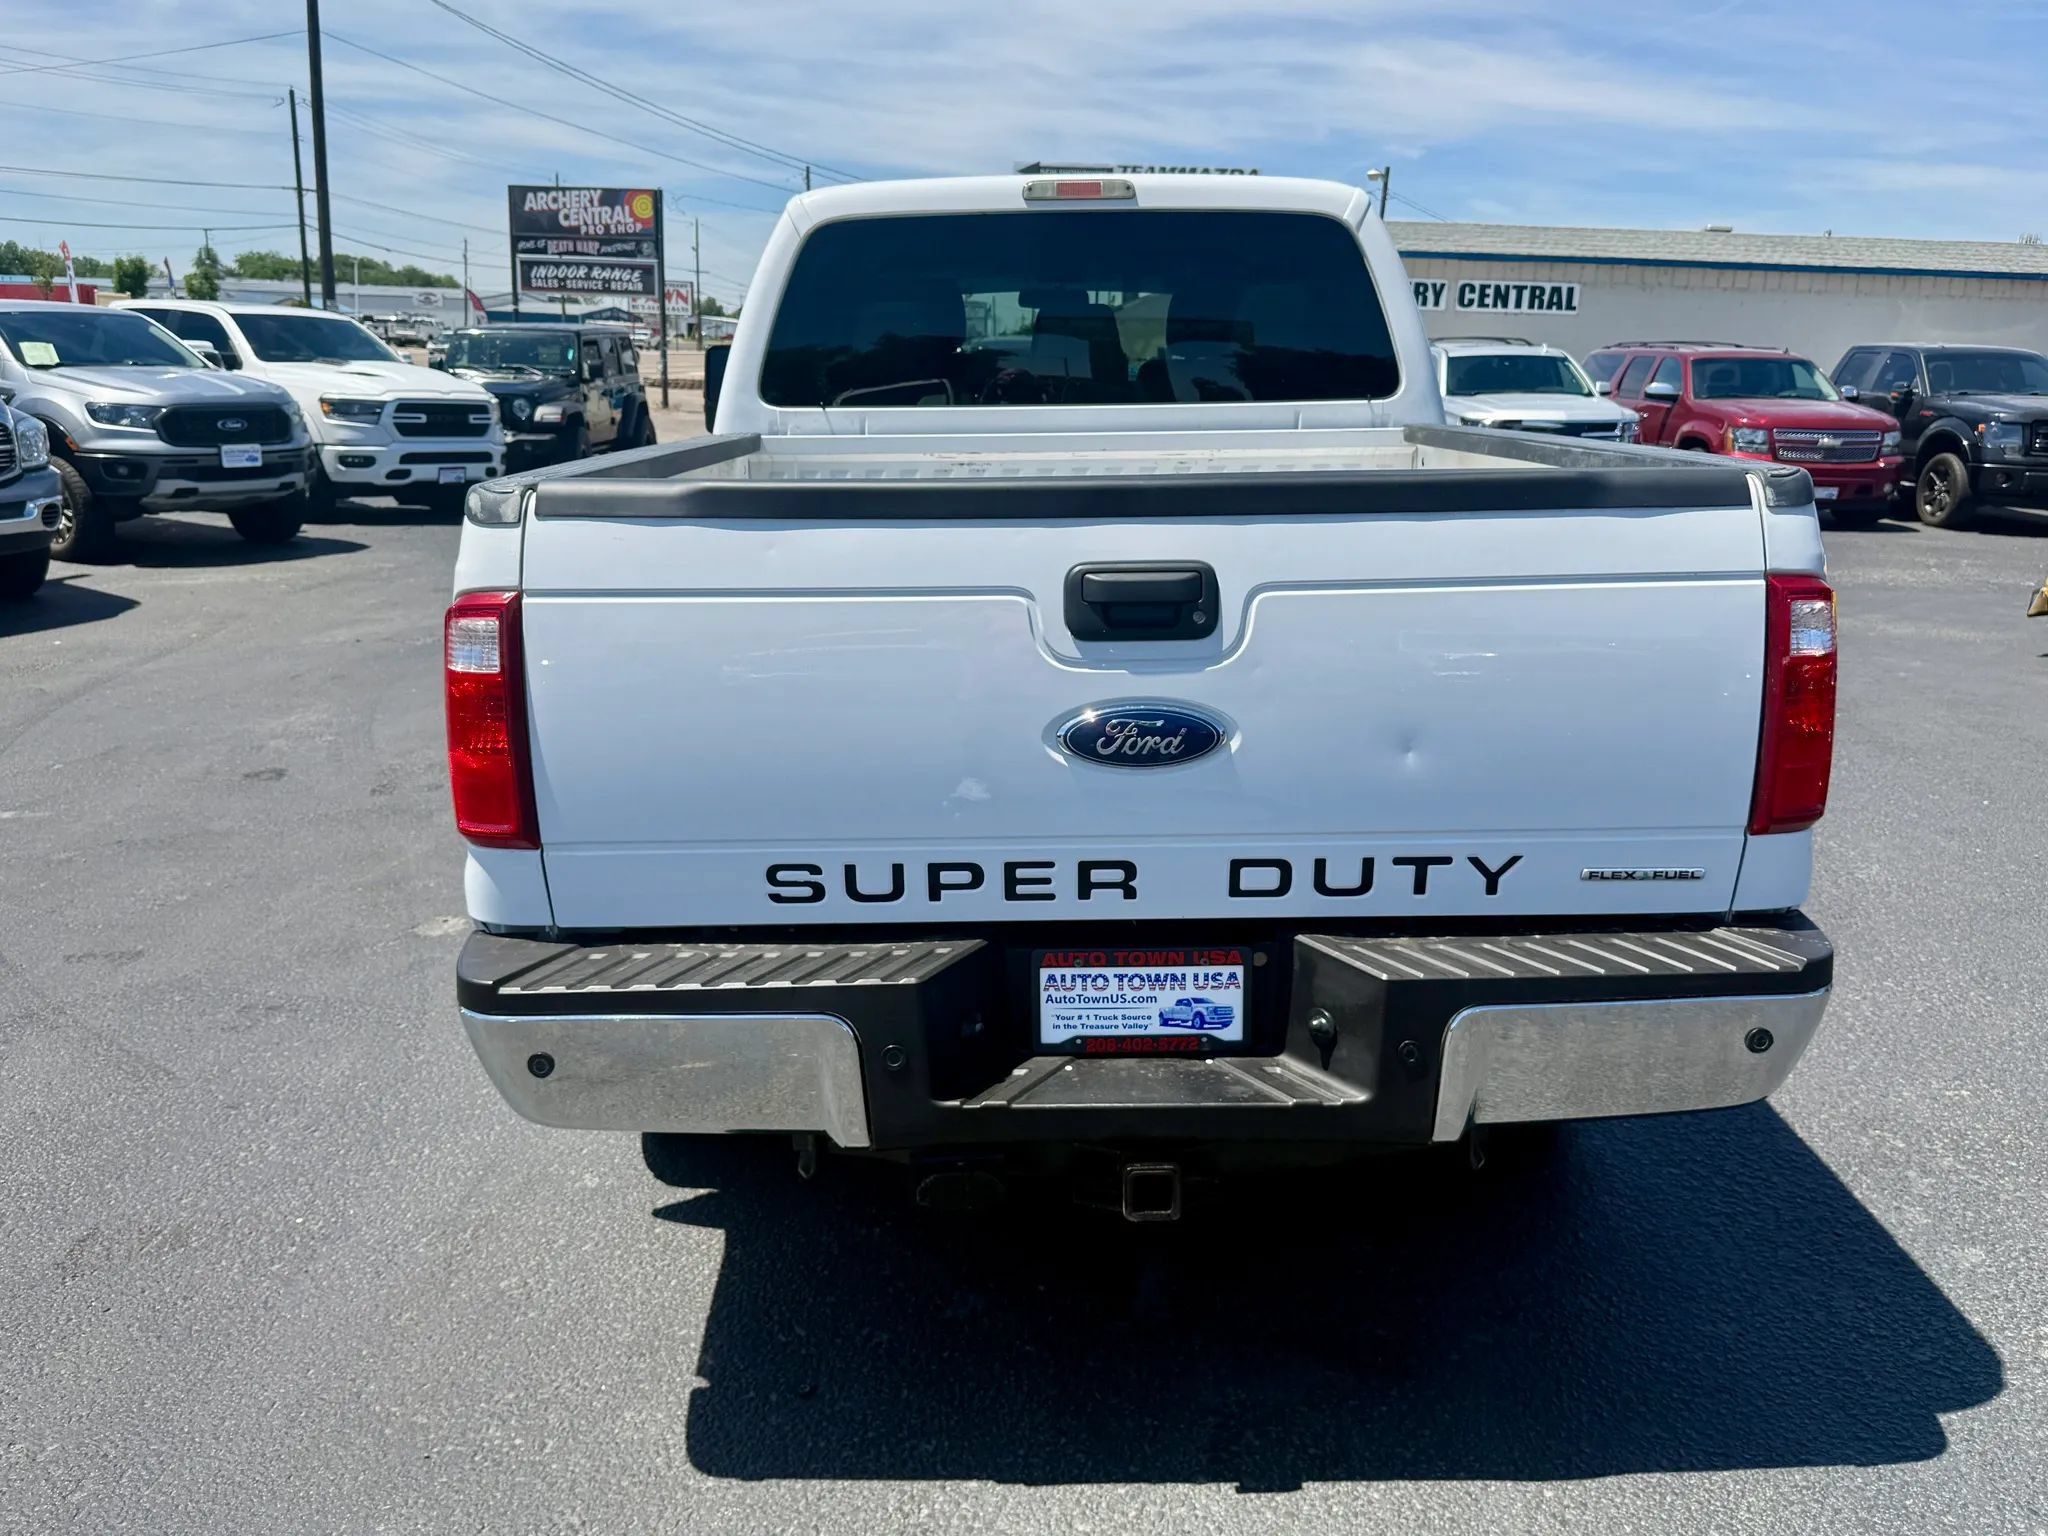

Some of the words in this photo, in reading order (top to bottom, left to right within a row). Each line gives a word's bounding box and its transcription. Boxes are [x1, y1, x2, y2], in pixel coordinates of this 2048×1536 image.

[524, 189, 602, 211] ARCHERY
[558, 205, 634, 227] CENTRAL
[580, 224, 605, 235] PRO
[610, 223, 643, 234] SHOP
[530, 265, 588, 279] INDOOR
[590, 266, 643, 282] RANGE
[531, 278, 559, 289] SALES
[566, 279, 603, 290] SERVICE
[610, 281, 643, 292] REPAIR
[1410, 281, 1446, 307] RY
[1457, 283, 1577, 311] CENTRAL
[1096, 718, 1188, 756] Ford
[765, 860, 1138, 904] SUPER
[1227, 855, 1524, 899] DUTY
[1588, 871, 1637, 880] FLEX
[1652, 870, 1702, 880] FUEL
[1042, 951, 1108, 966] AUTO
[1114, 951, 1185, 966] TOWN
[1194, 950, 1242, 965] USA
[1043, 973, 1110, 992] AUTO
[1113, 973, 1187, 992] TOWN
[1192, 971, 1241, 990] USA
[1045, 993, 1158, 1004] AutoTownUS.com
